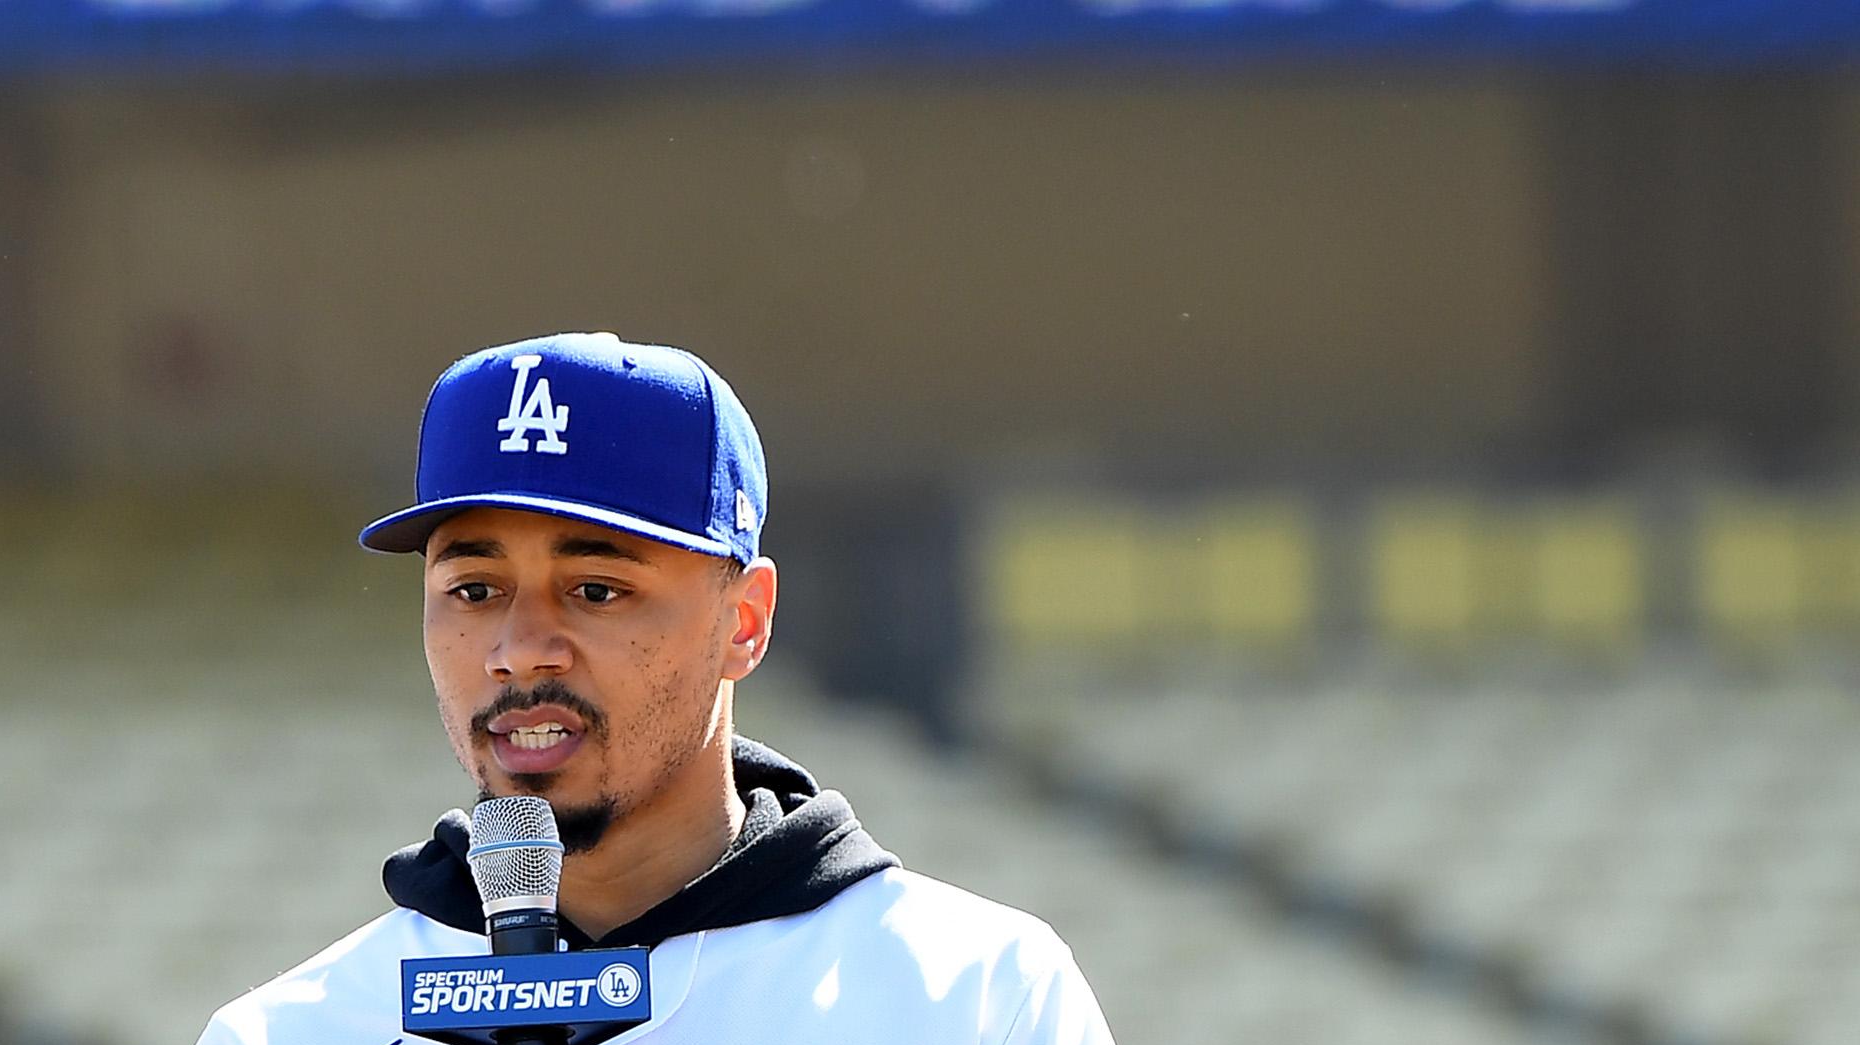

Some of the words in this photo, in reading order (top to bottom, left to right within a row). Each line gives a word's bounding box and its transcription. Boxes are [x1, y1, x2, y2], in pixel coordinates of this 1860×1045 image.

[497, 354, 569, 454] LA
[415, 969, 504, 988] SPECTRUM
[610, 971, 629, 998] LA
[411, 979, 597, 1015] SPORTSNET
